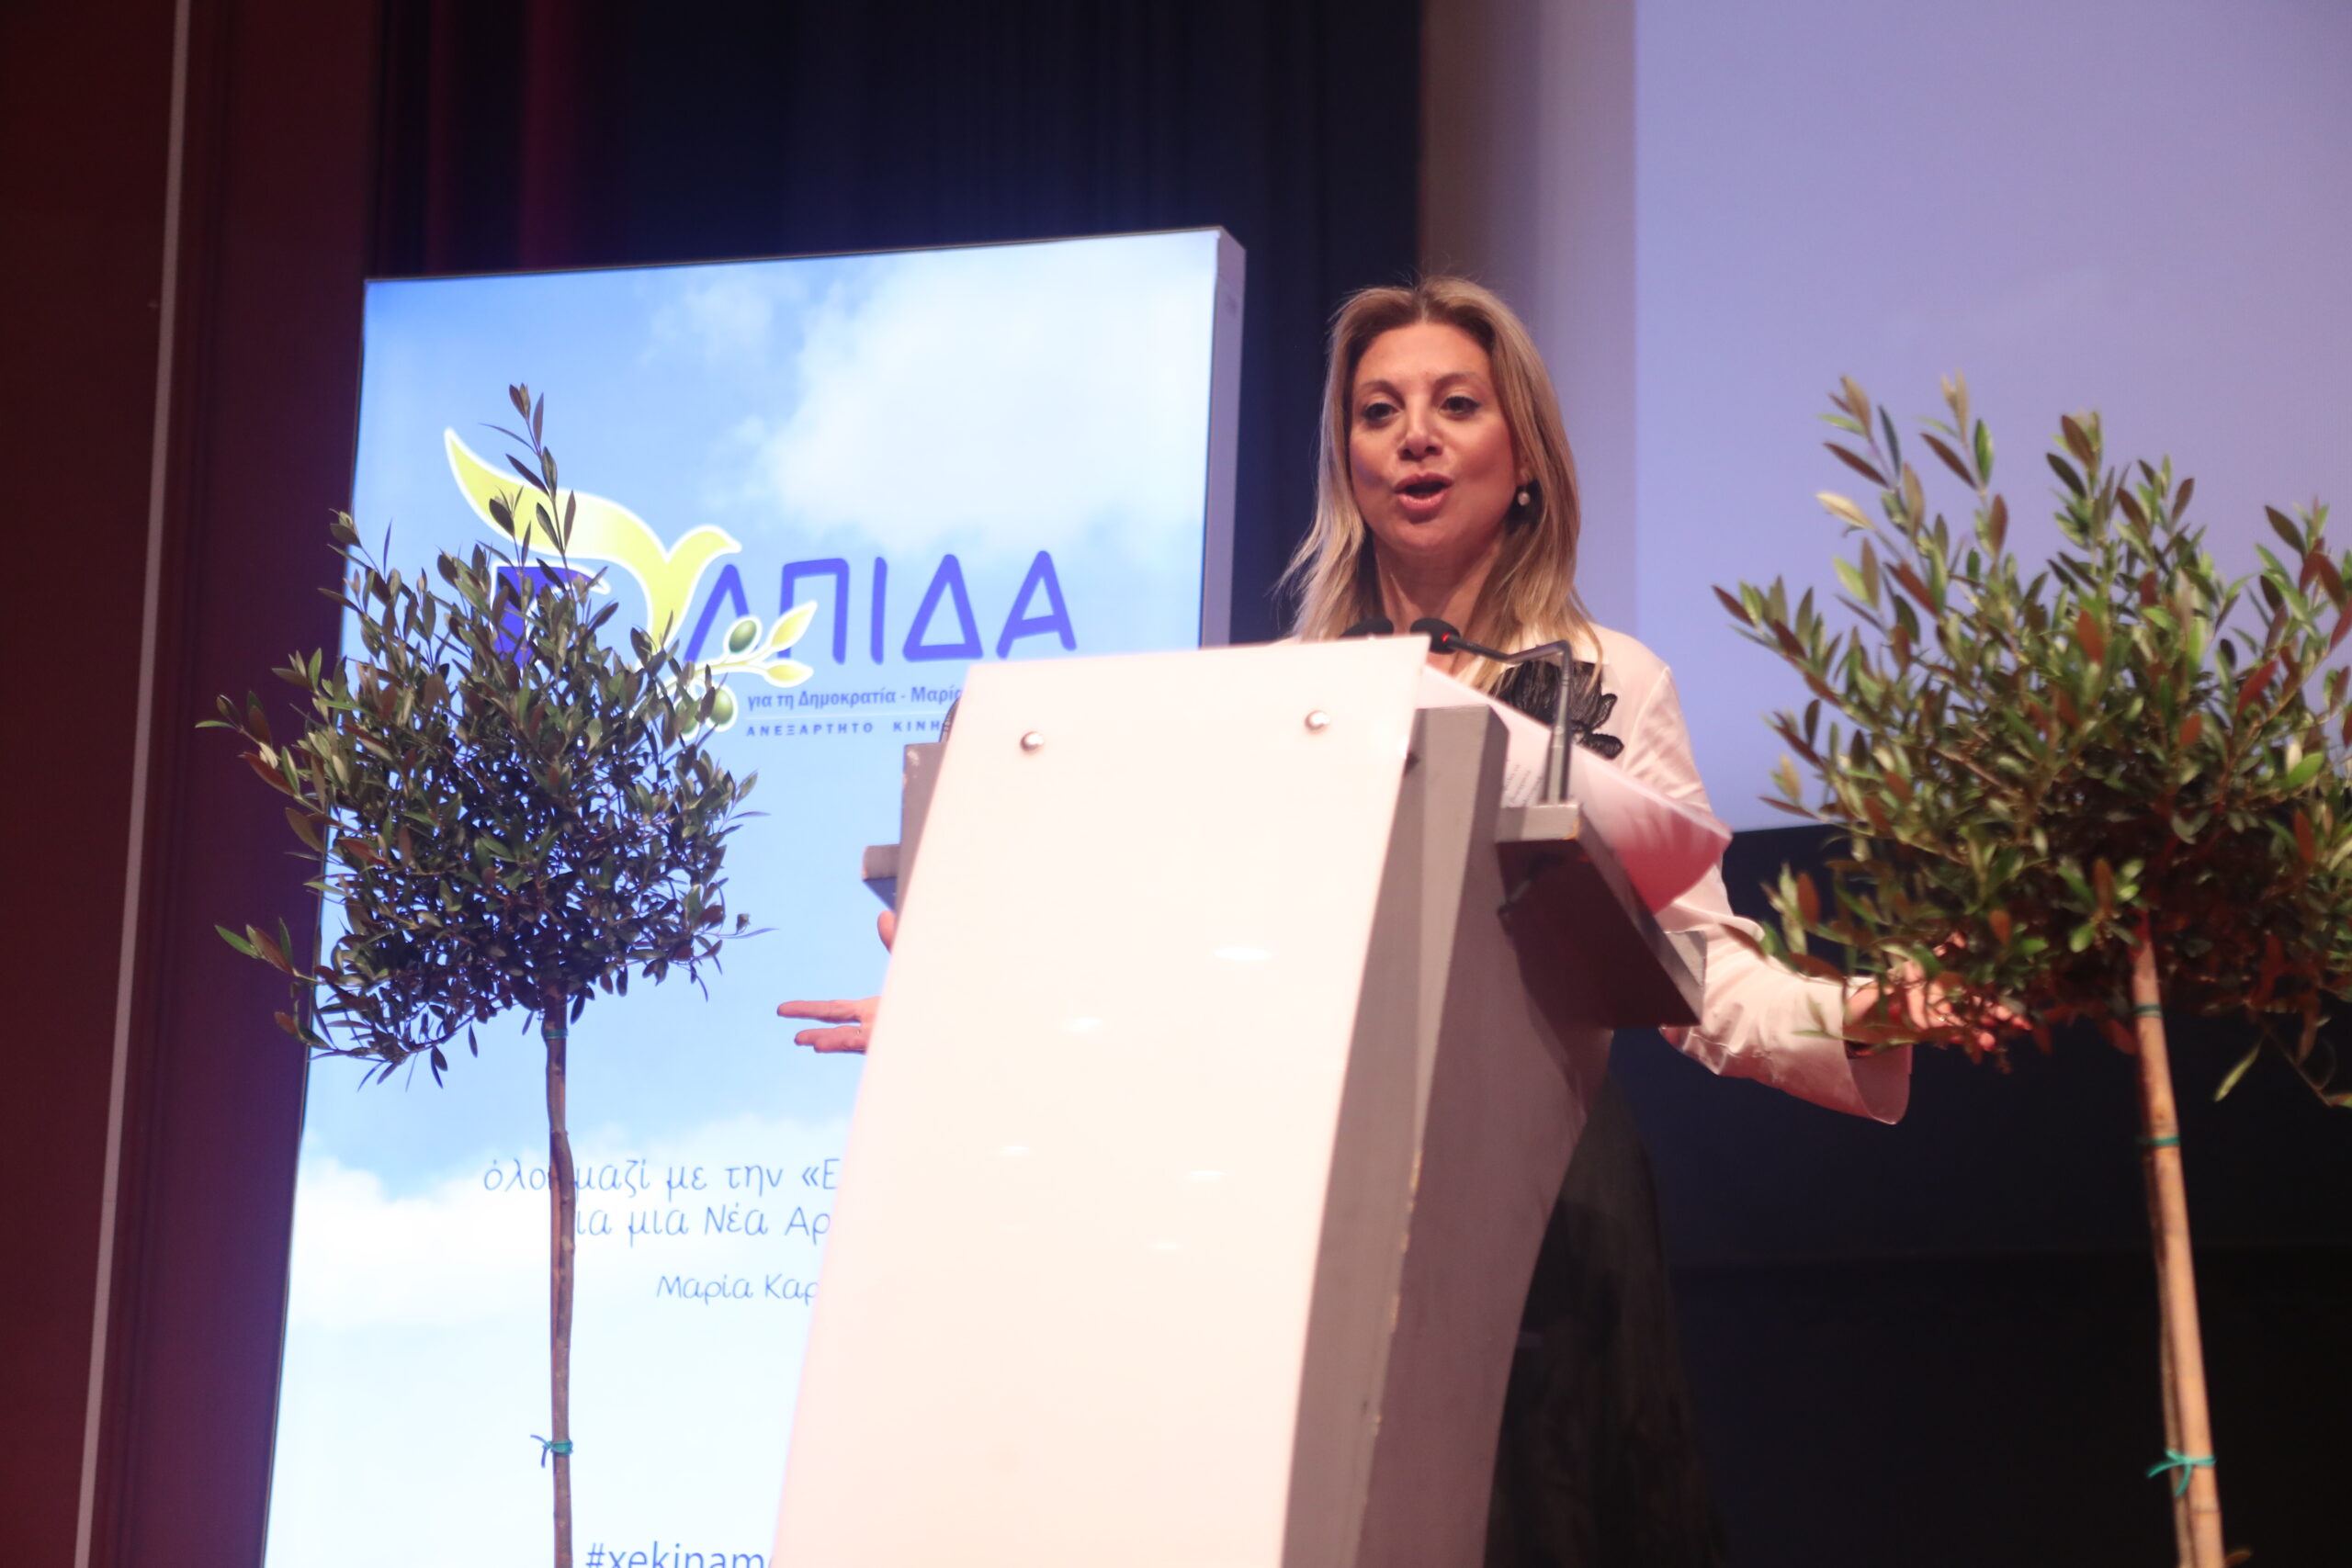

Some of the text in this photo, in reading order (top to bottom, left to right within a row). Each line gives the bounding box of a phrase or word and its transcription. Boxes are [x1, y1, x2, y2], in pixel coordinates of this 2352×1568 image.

[747, 694, 772, 711] για
[776, 694, 794, 710] τη
[798, 688, 897, 709] Δημοκρατία
[746, 720, 941, 736] ΑΝΕΞΑΡΤΗΤΟ ΚΙΝΗ
[483, 1158, 842, 1203] όλο μαζί με την «Ε
[576, 1201, 832, 1249] ια μια Νέα Αρ
[656, 1273, 820, 1306] Μαρία Καρ
[585, 1540, 772, 1568] #xekinam
